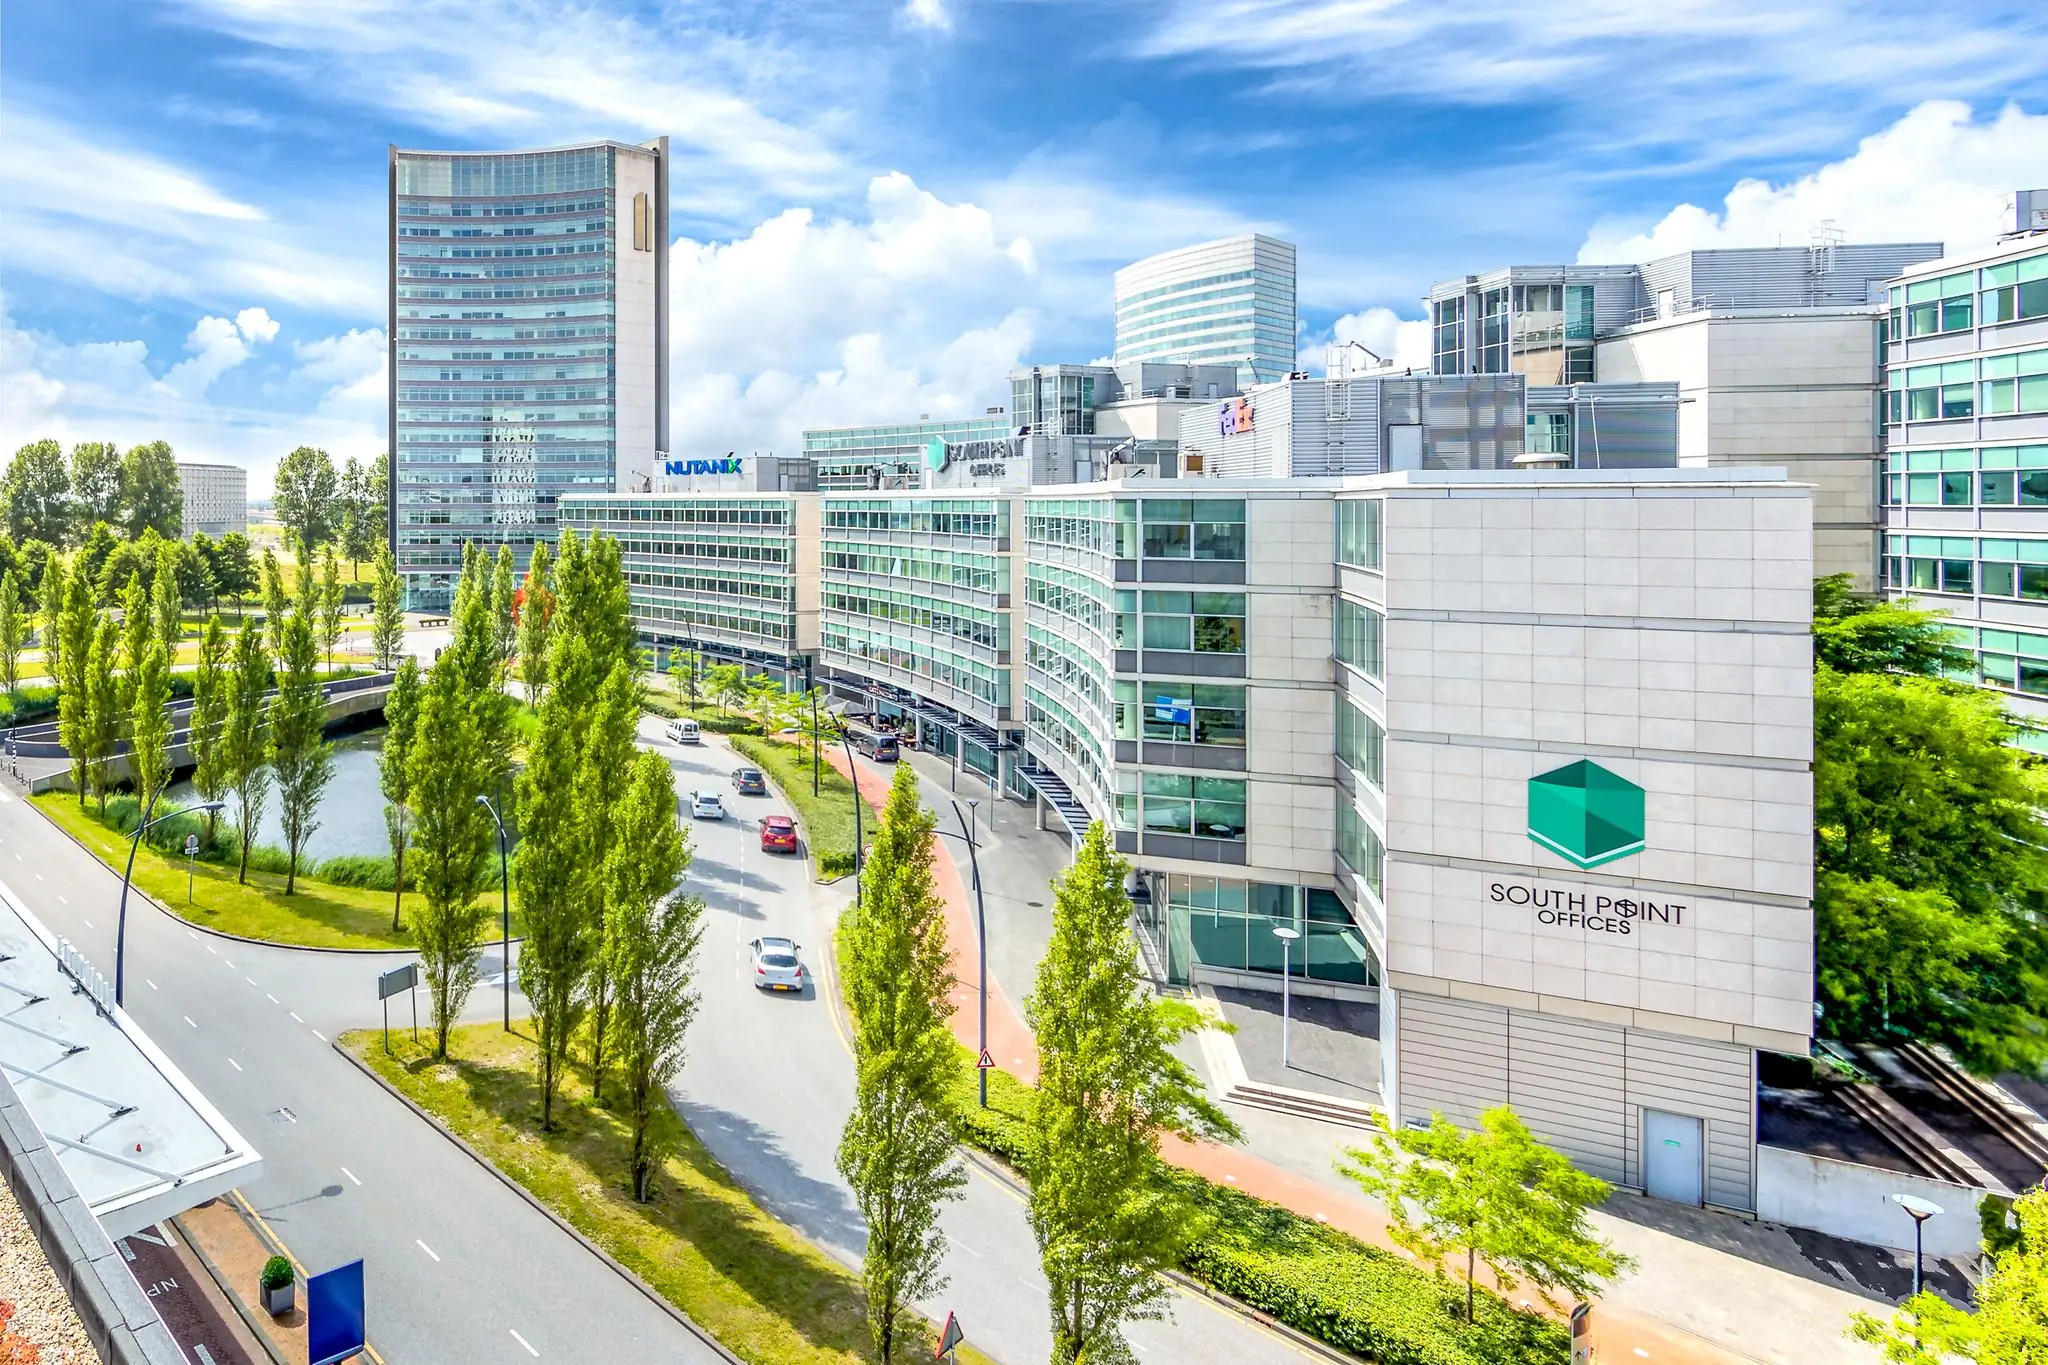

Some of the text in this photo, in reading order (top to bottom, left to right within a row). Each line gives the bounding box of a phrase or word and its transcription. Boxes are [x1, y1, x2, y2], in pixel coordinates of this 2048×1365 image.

[665, 458, 743, 476] NUTANIX
[1490, 883, 1586, 913] SOUTH
[1537, 910, 1631, 935] OFFICES
